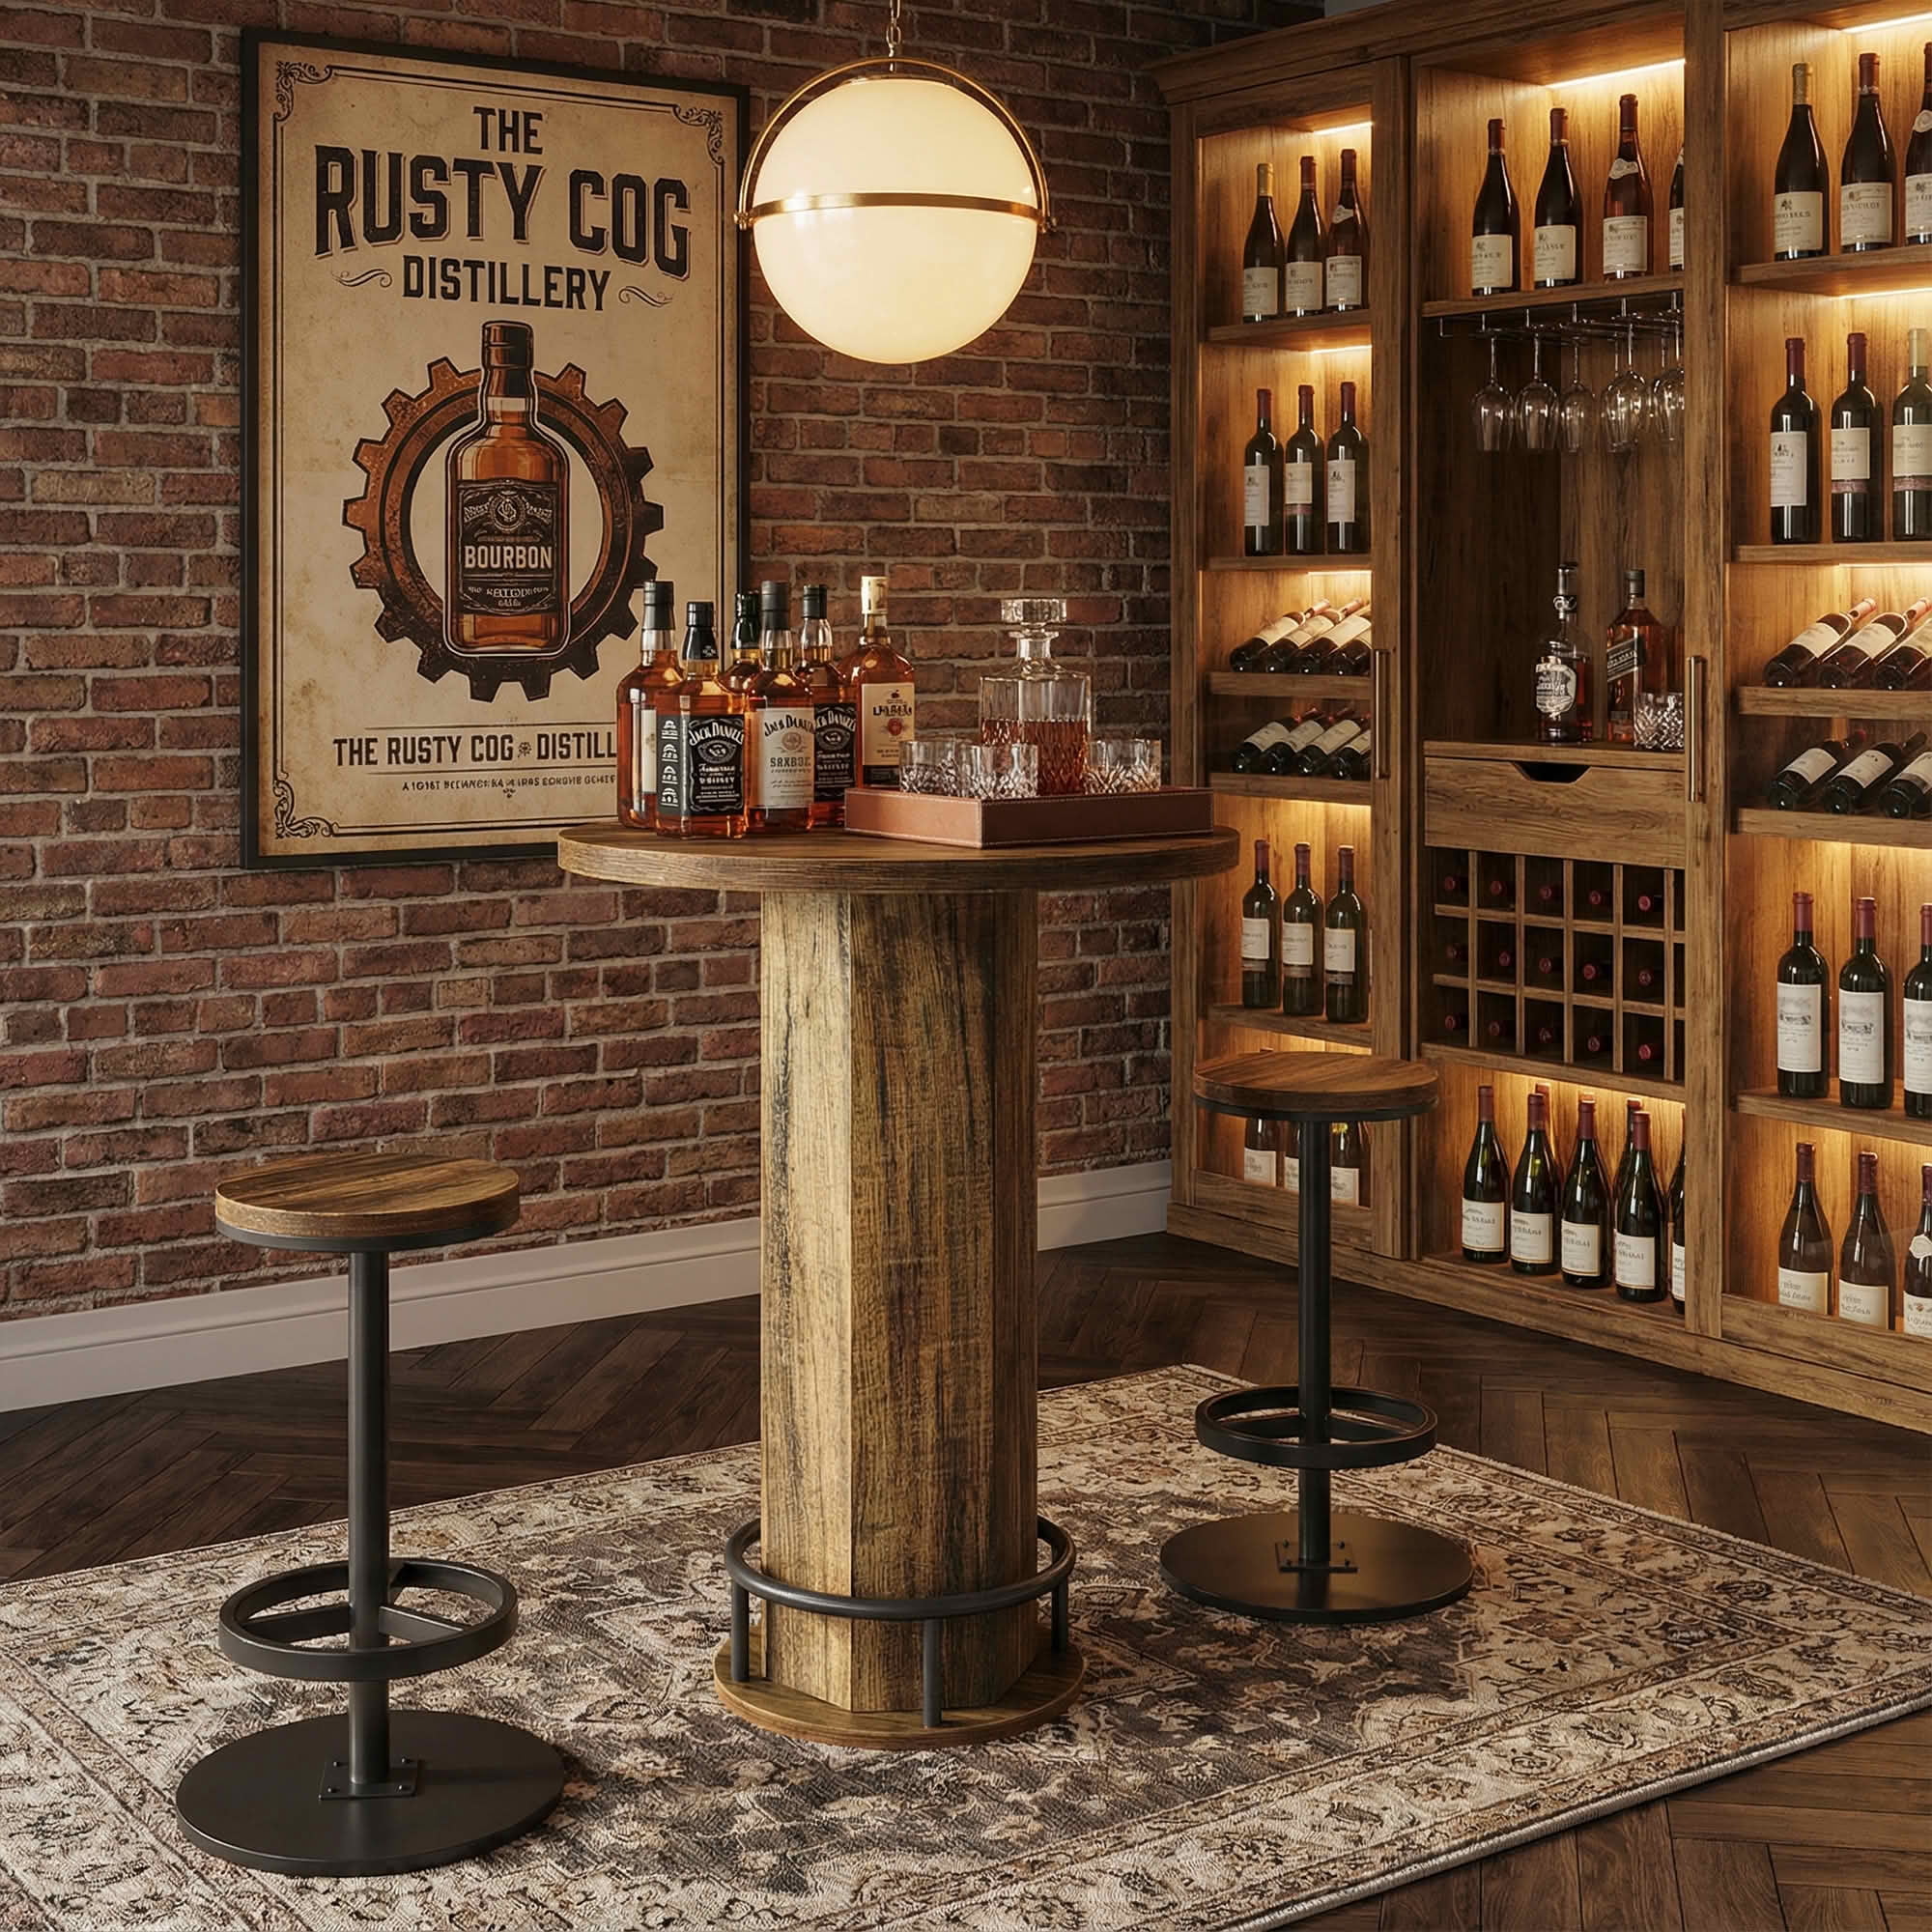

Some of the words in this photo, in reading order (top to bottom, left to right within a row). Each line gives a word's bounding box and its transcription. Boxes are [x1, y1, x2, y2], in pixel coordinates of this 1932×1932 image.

[473, 105, 543, 156] THE
[315, 145, 544, 260] RUSTY
[569, 168, 691, 282] COG
[403, 255, 611, 311] DISTILLERY
[464, 545, 553, 569] BOURBON
[333, 737, 378, 766] THE
[387, 735, 462, 765] RUSTY
[470, 733, 514, 762] COG
[537, 731, 617, 760] DISTILL
